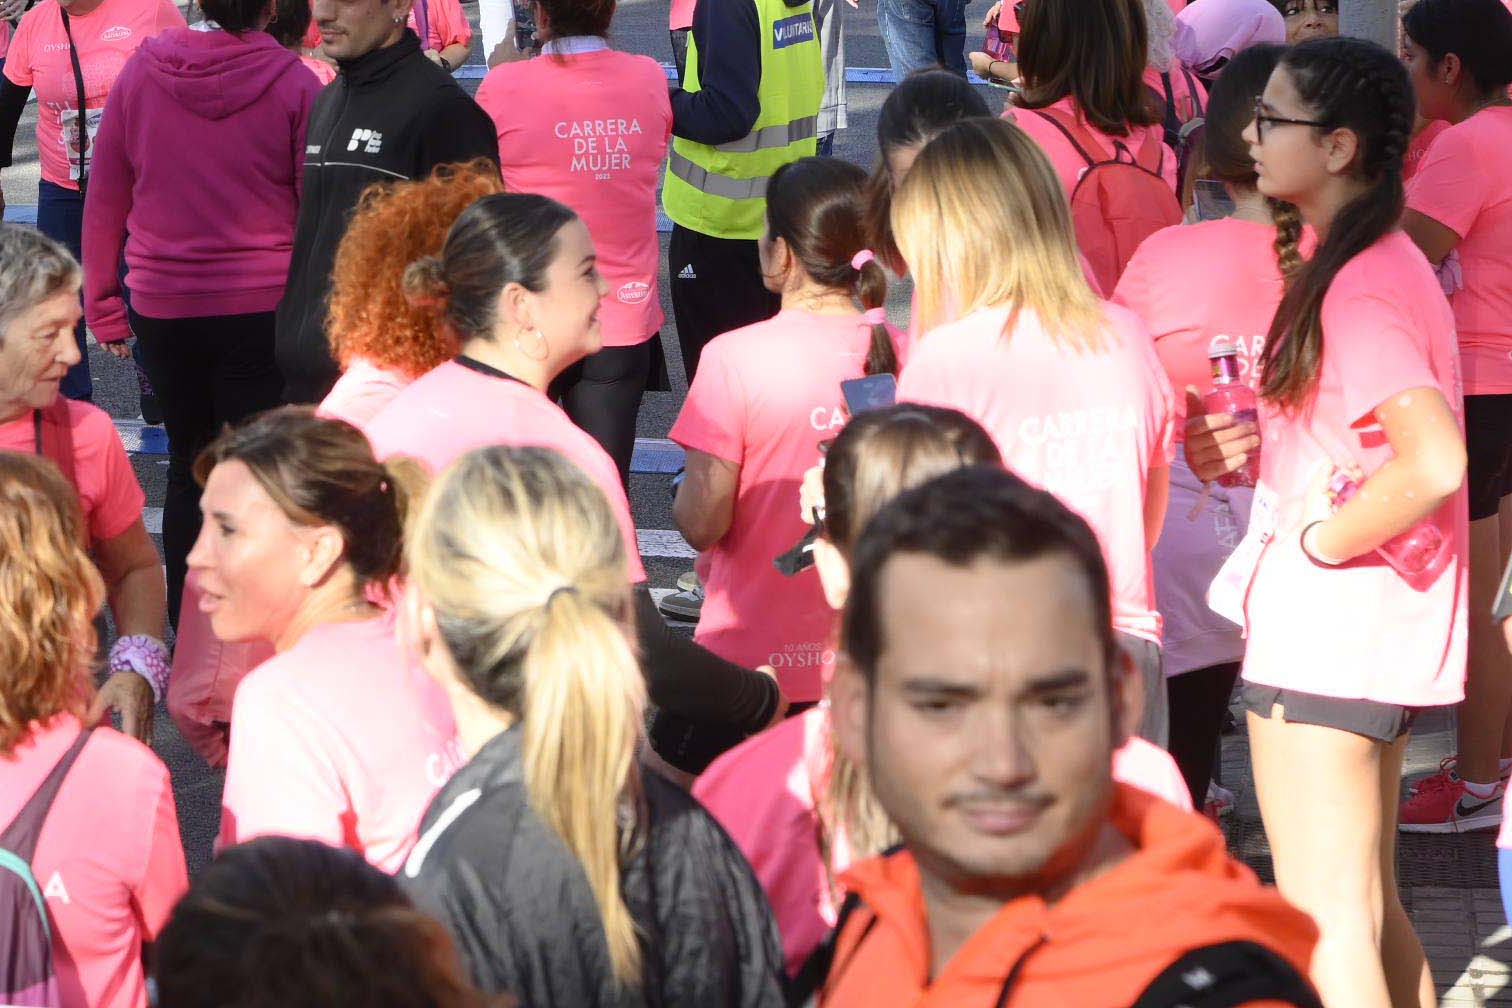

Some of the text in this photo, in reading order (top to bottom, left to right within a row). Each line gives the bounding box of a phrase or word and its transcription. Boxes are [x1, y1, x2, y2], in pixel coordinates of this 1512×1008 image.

[554, 118, 643, 139] CARRERA
[573, 137, 627, 155] DE LA
[569, 153, 631, 173] MUJER
